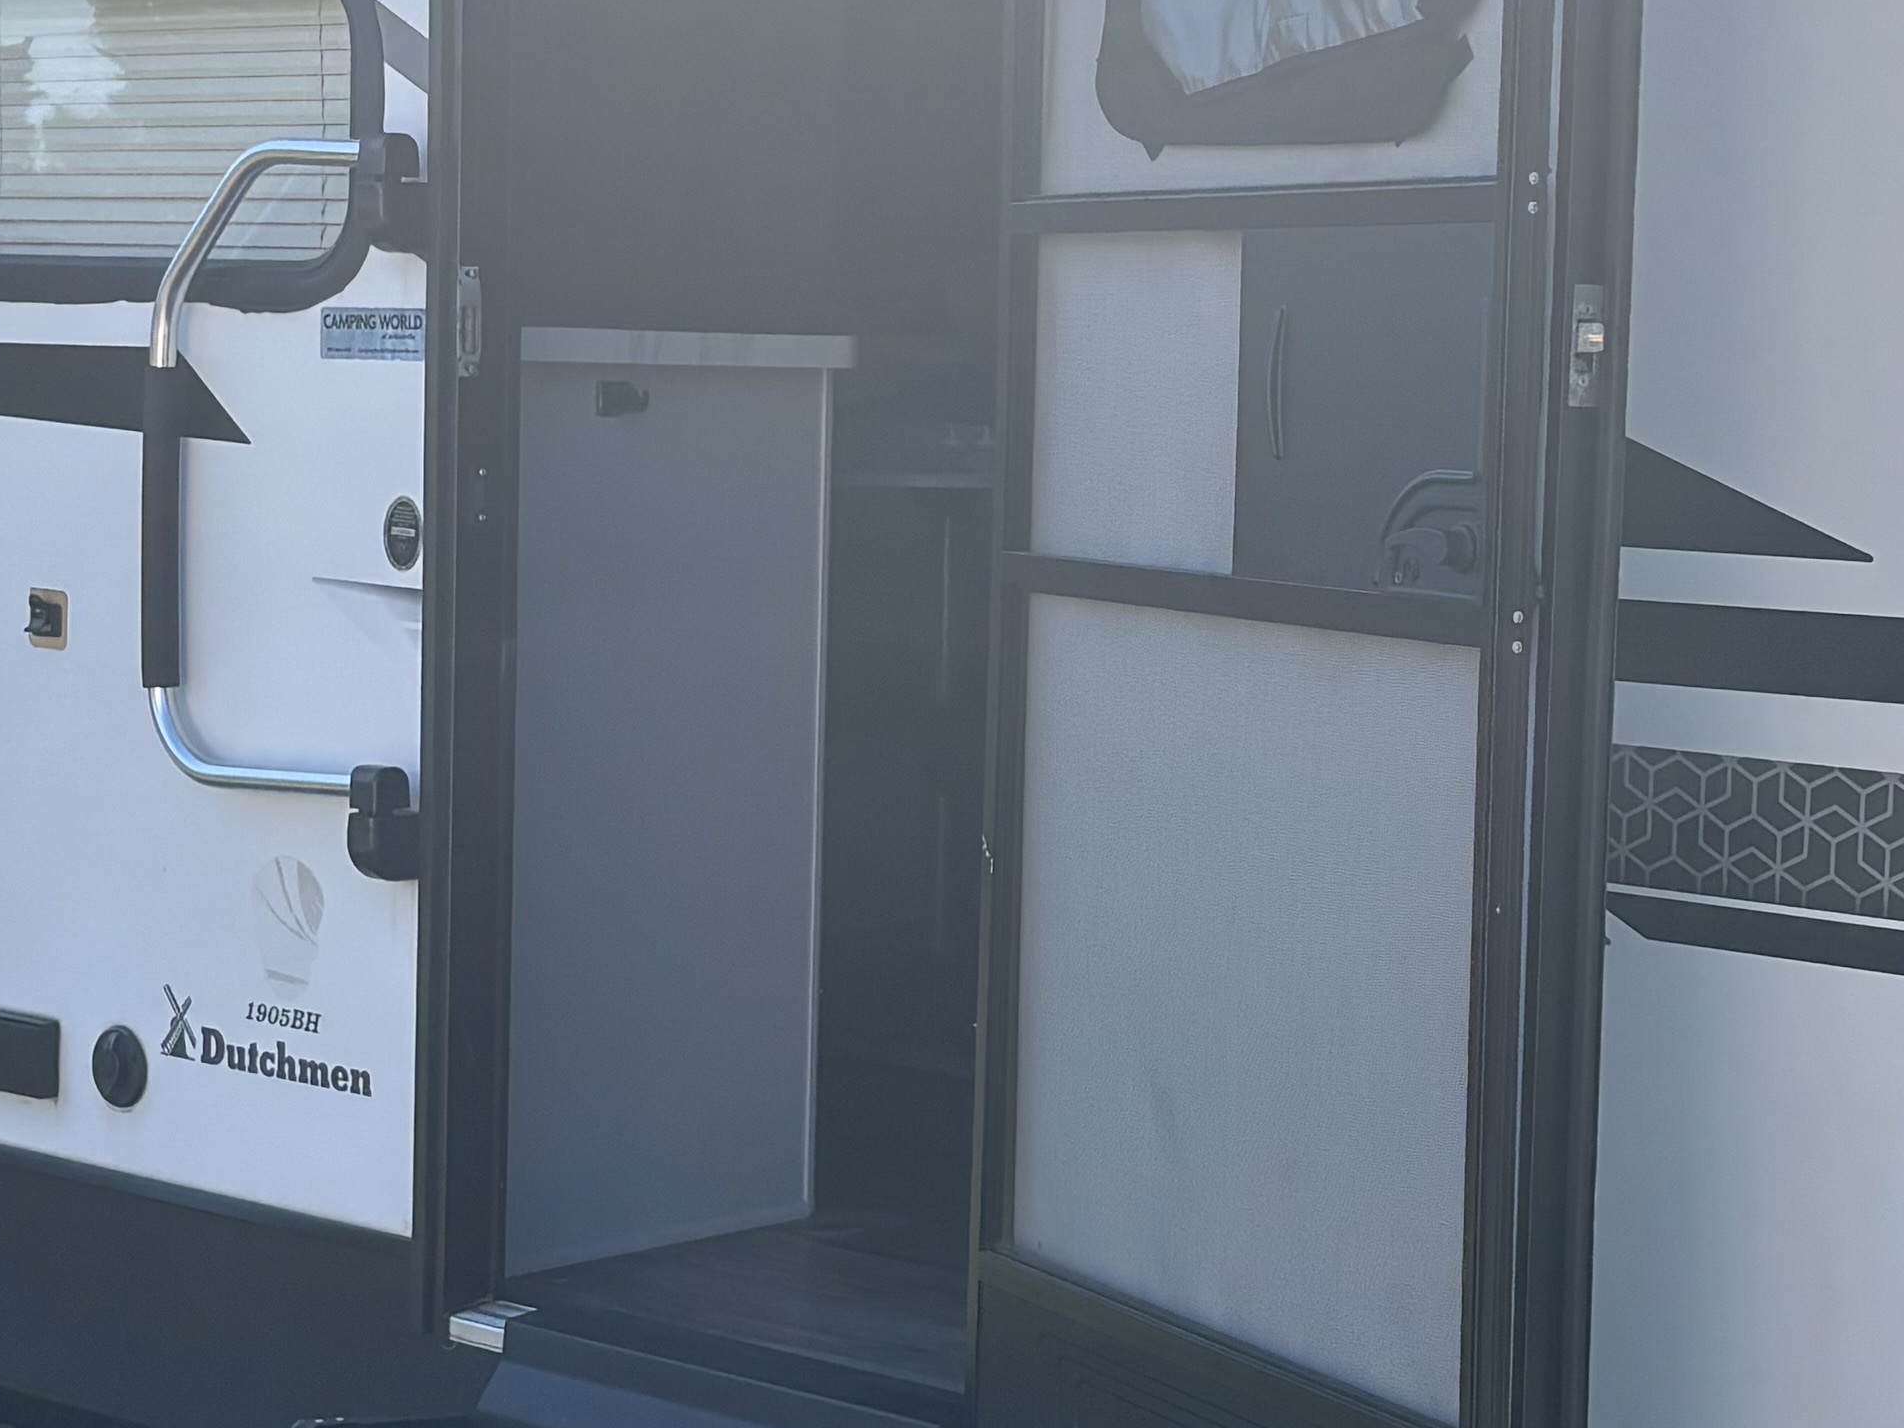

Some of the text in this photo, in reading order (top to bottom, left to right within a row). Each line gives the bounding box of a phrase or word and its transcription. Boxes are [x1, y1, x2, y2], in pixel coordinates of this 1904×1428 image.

[323, 313, 423, 331] CAMPING WORLD
[246, 1001, 322, 1034] 1905BH
[200, 1026, 372, 1097] Dutchmen
